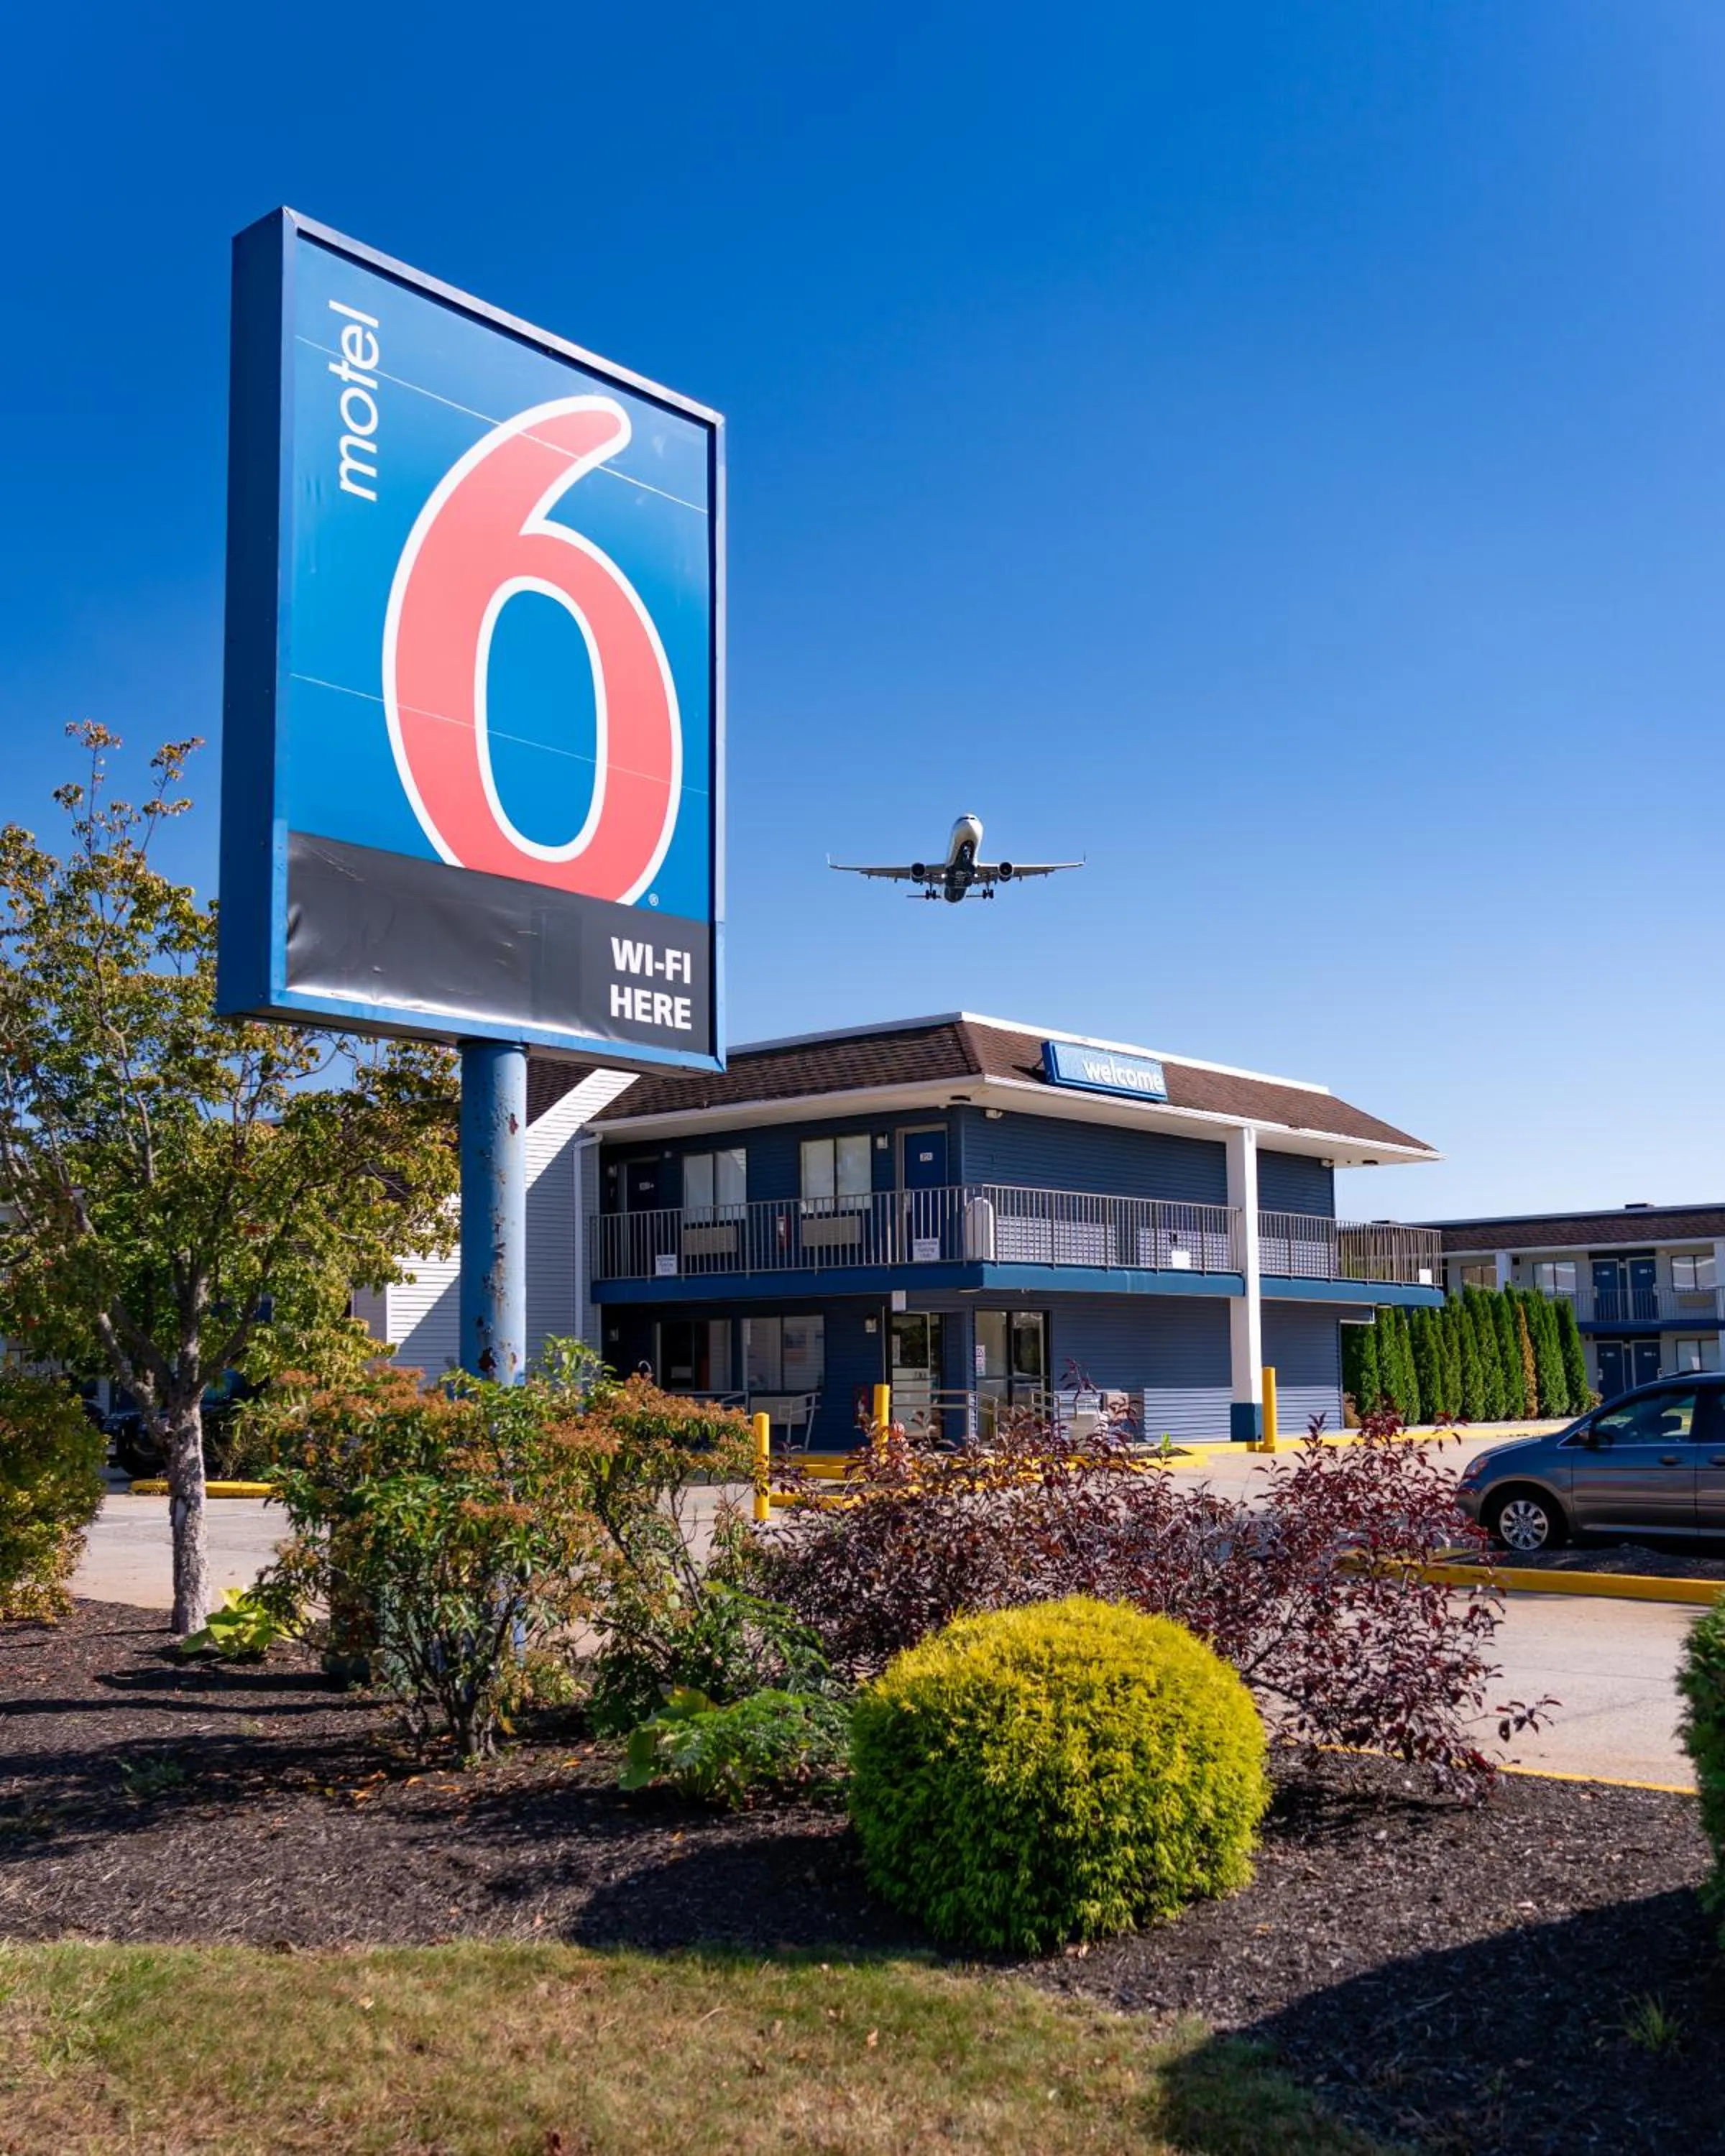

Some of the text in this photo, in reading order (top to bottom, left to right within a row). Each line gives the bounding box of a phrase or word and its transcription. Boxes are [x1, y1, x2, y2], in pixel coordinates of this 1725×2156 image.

[328, 300, 379, 502] motel
[382, 394, 683, 907] 6
[610, 936, 691, 984] WI-FI
[610, 984, 692, 1030] HERE
[1083, 1056, 1165, 1092] welcome
